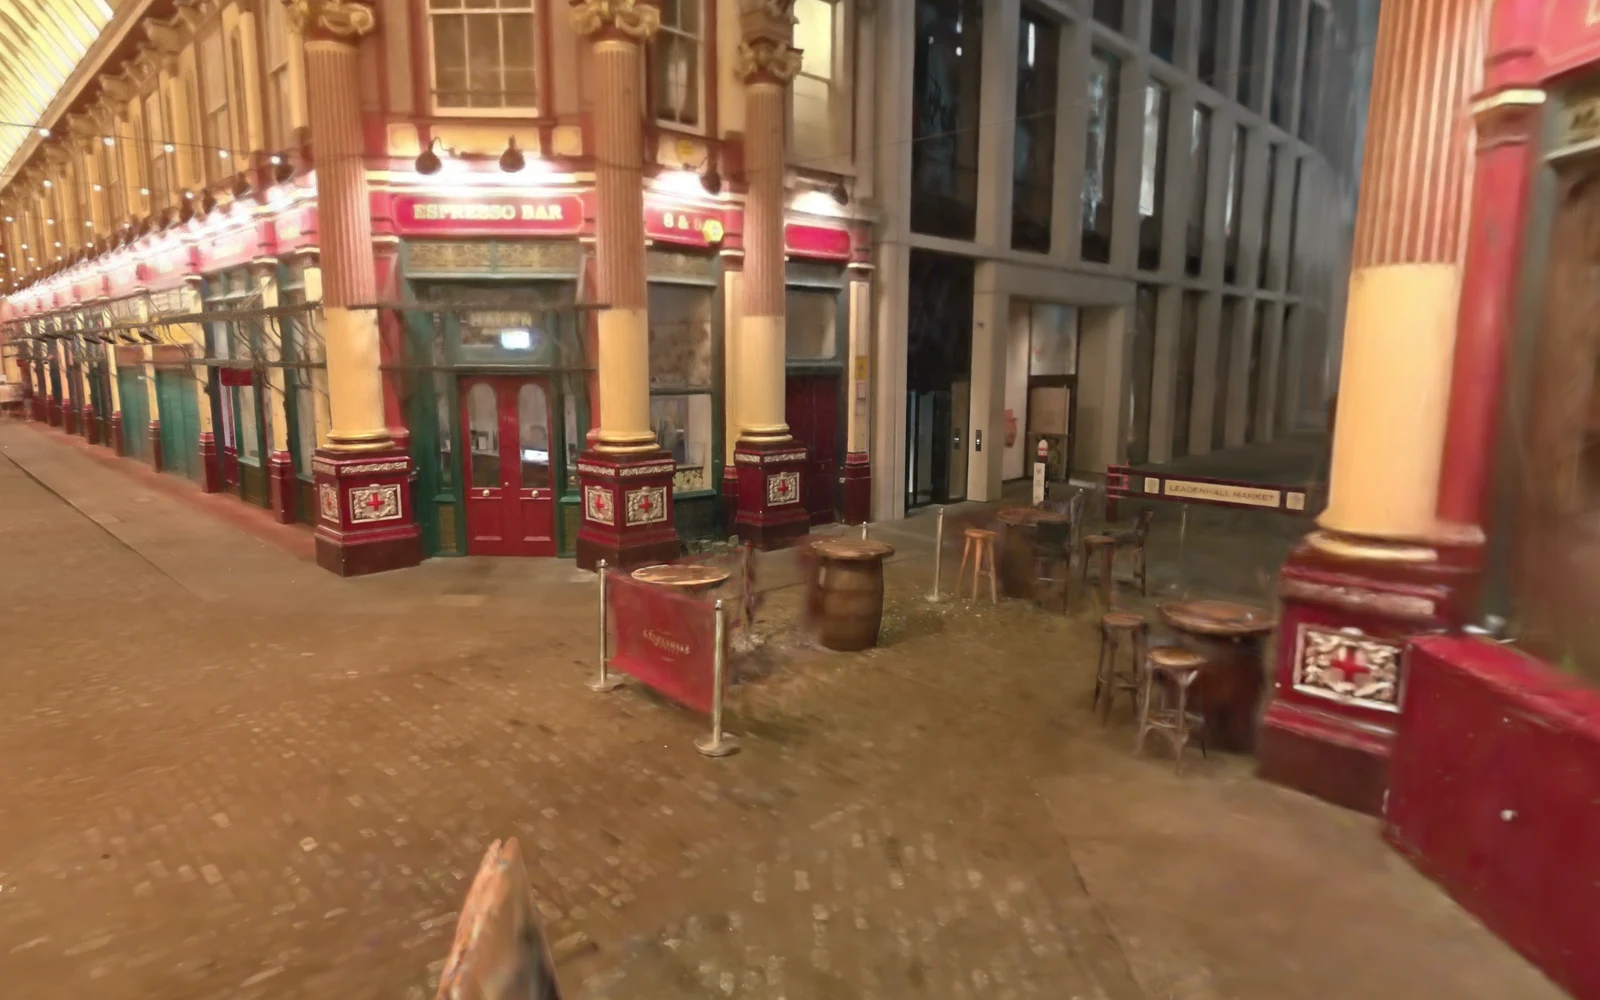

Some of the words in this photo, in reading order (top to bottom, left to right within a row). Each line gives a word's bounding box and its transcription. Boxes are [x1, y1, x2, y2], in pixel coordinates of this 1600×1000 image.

[413, 203, 516, 220] ESPRESSO
[521, 203, 564, 220] BAR
[1169, 484, 1228, 497] LEADENHALL
[1232, 490, 1275, 502] MARKET
